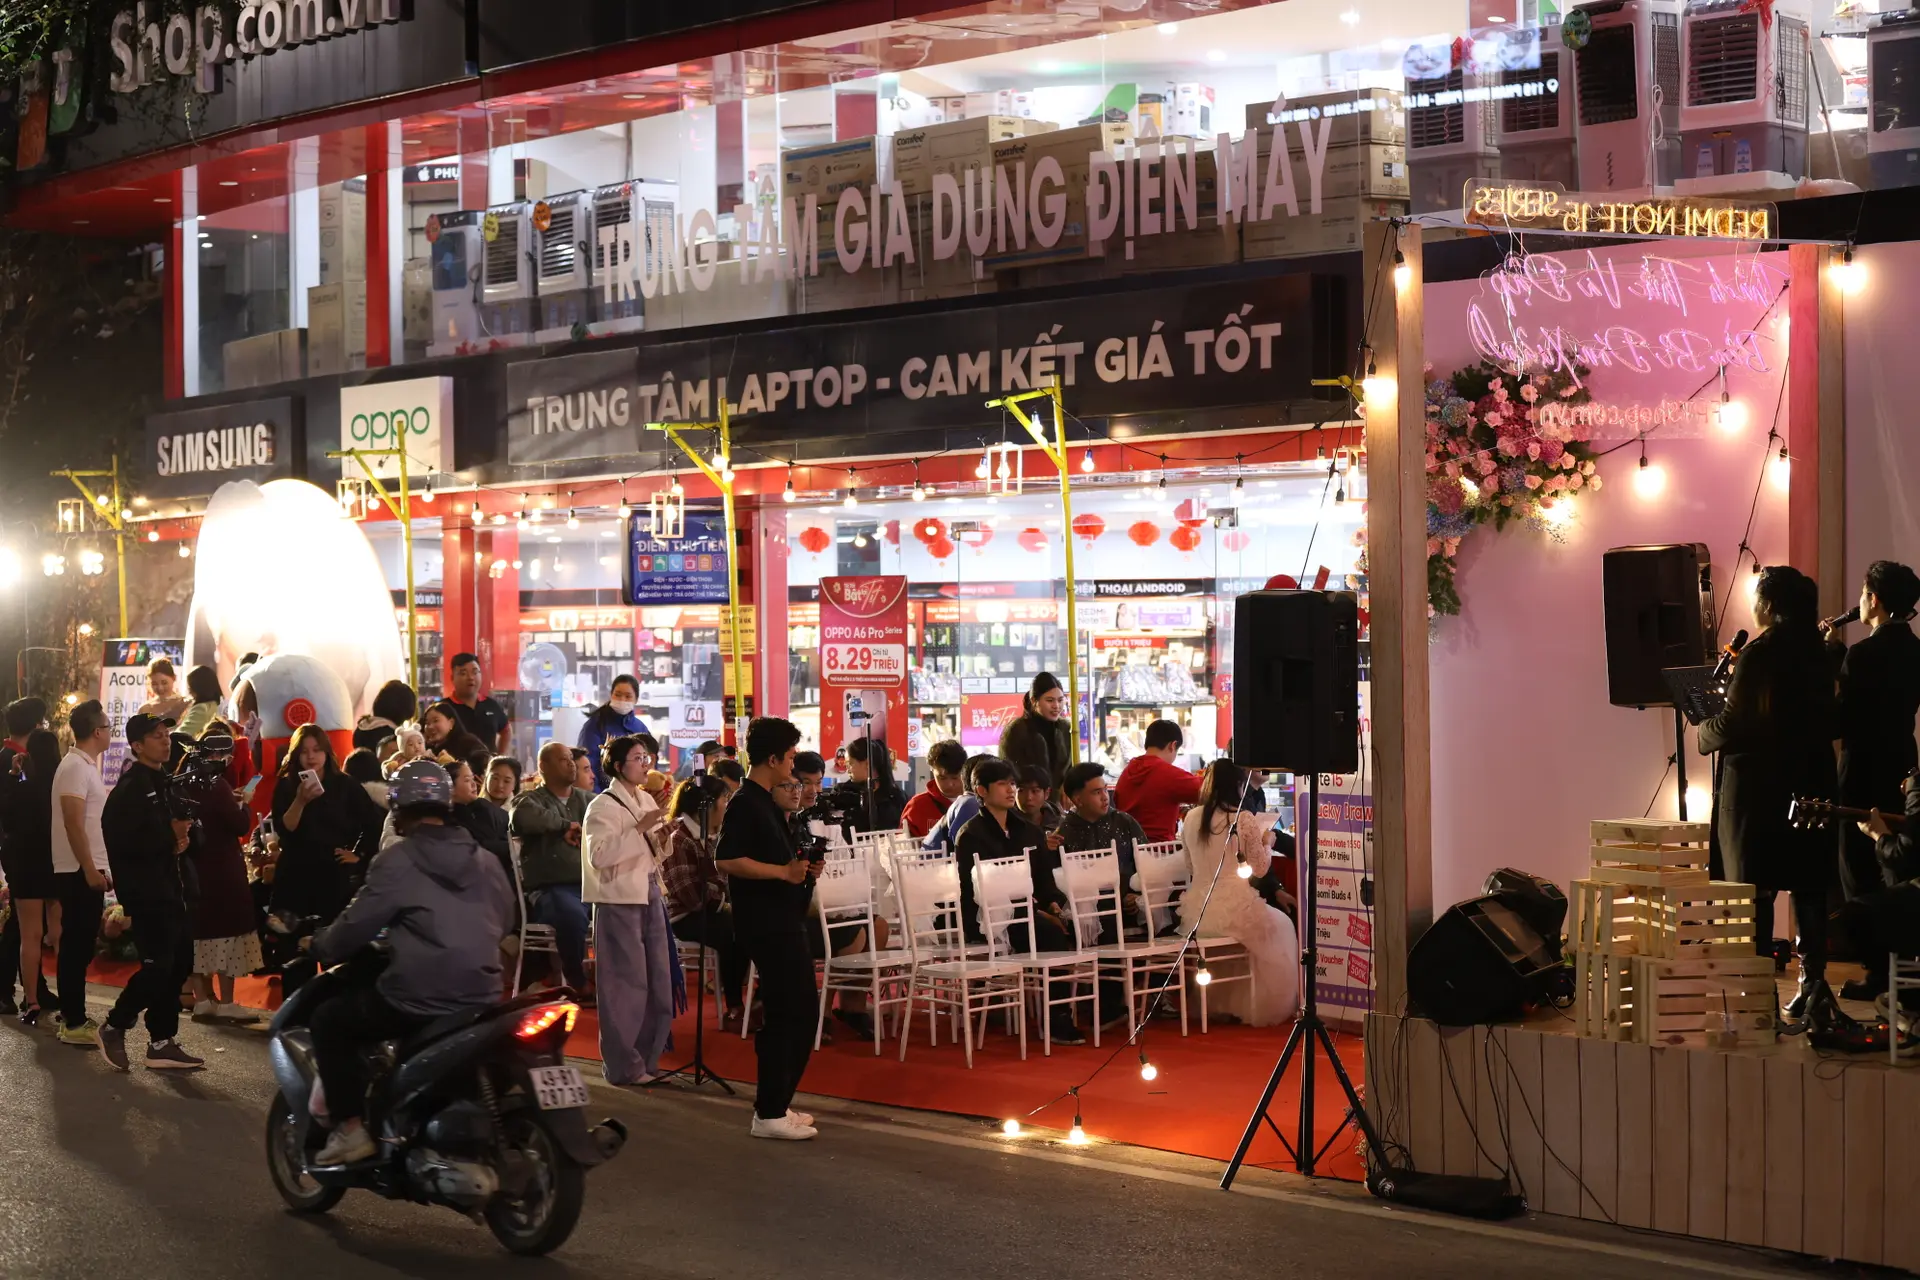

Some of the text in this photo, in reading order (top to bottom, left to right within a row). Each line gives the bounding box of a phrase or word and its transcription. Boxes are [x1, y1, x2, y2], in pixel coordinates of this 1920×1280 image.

[597, 91, 1332, 303] TRUNG TÂM GIA DỤNG ĐIỆN MÁY
[527, 303, 1282, 435] TRUNG TÂM LAPTOP - CAM KẾT GIÁ TỐT
[157, 423, 268, 476] SAMSUNG
[1136, 583, 1186, 594] ANDROID
[825, 626, 902, 639] OPPO A6 Pro Series
[826, 647, 872, 670] 8.29
[873, 657, 898, 672] TRIỆU
[1332, 773, 1343, 786] 15
[1318, 801, 1341, 824] ucky
[1333, 839, 1346, 849] Note
[1325, 850, 1337, 860] 7.49
[1337, 851, 1349, 862] triệu
[1325, 875, 1339, 888] nghe
[1332, 890, 1346, 901] Buds
[1347, 891, 1351, 901] 4
[1317, 915, 1340, 926] Voucher
[1320, 953, 1344, 965] Voucher
